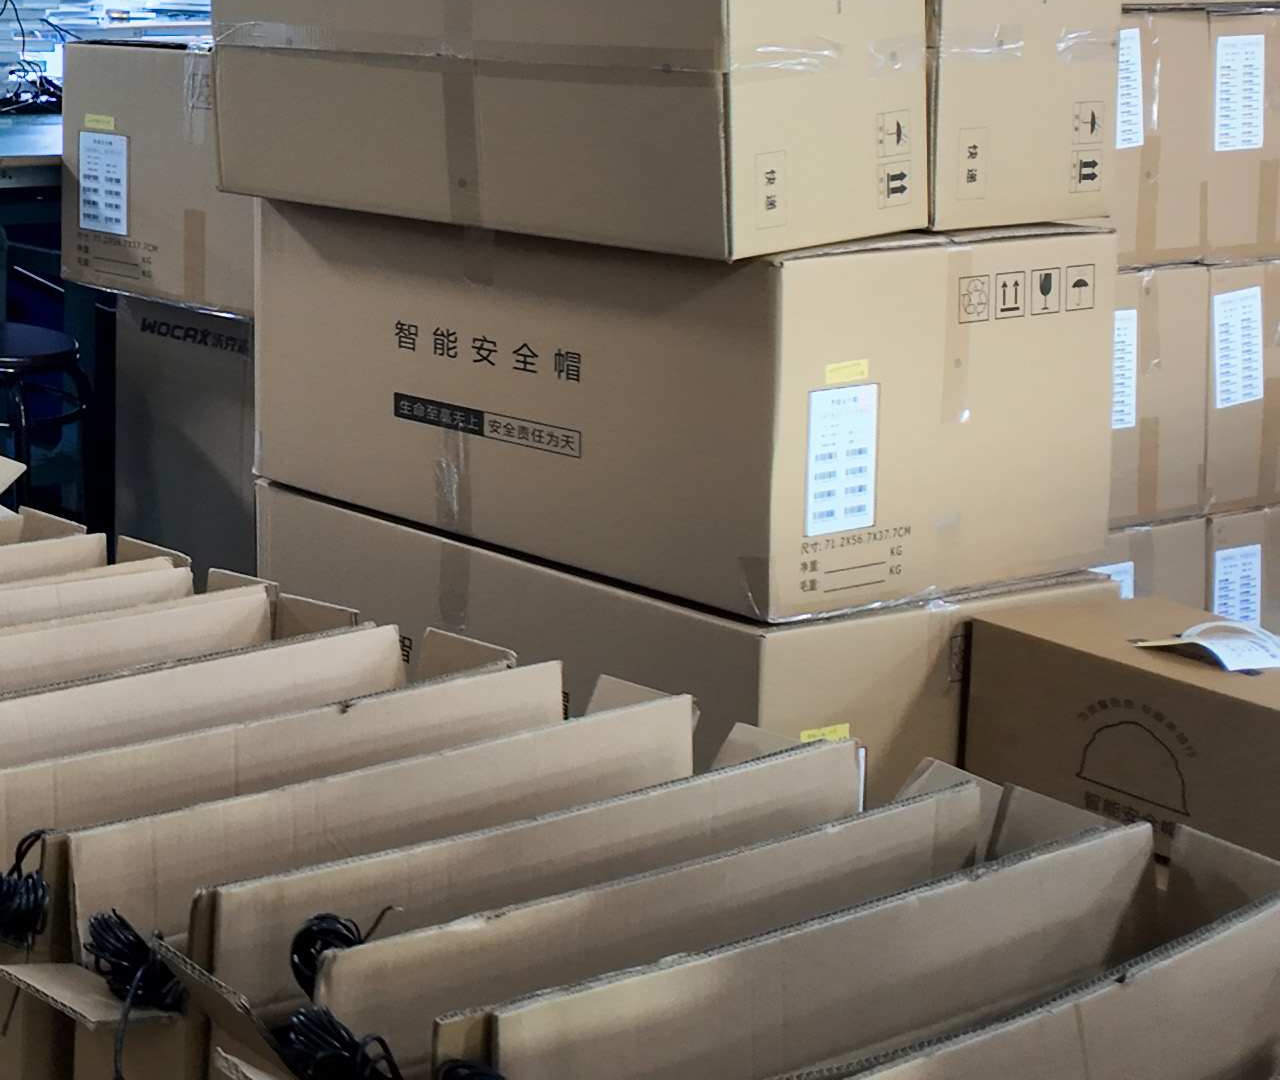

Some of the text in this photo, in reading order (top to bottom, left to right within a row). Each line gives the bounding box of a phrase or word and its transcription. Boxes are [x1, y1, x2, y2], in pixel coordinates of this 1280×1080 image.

[395, 320, 581, 383] 智能安全帽
[488, 418, 576, 452] 安全责任为天
[890, 545, 903, 557] KG
[889, 564, 902, 576] KG
